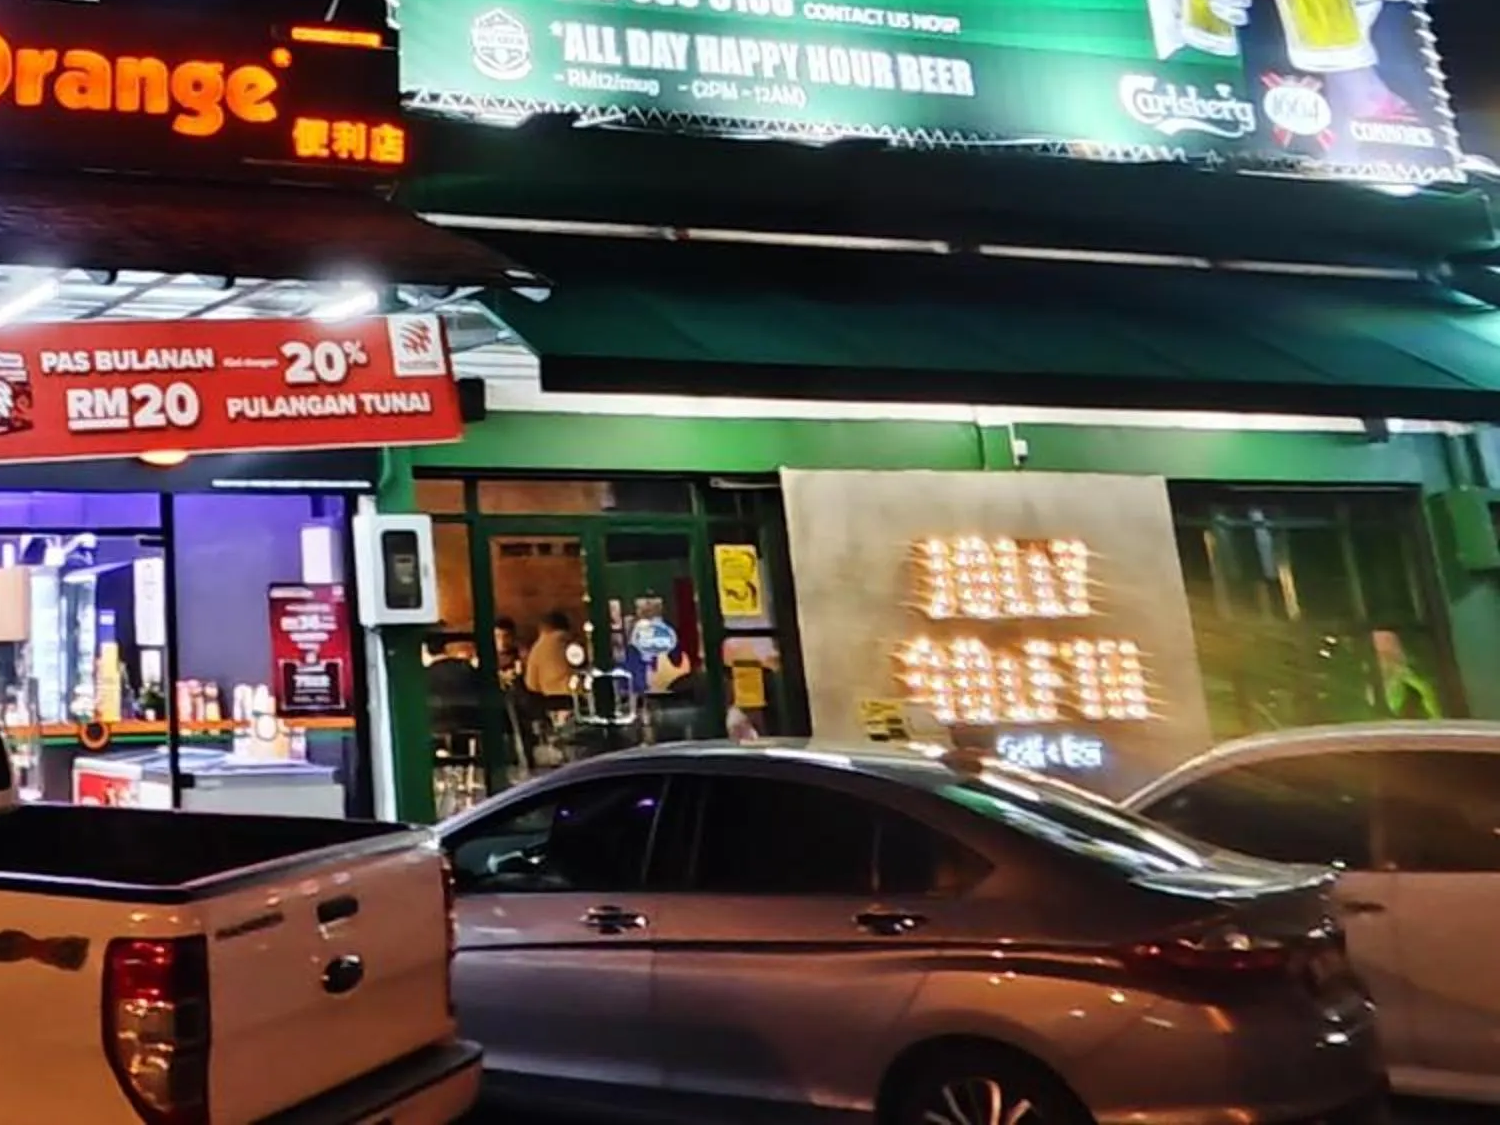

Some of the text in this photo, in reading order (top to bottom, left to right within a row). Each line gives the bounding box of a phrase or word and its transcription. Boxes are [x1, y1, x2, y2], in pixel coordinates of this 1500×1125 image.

[803, 3, 885, 26] CONTACT
[886, 10, 910, 28] US
[625, 28, 690, 71] DAY
[694, 33, 799, 81] HAPPY
[805, 43, 895, 90] HOUR
[896, 52, 976, 97] BEER
[1118, 74, 1256, 133] Carlsberg
[41, 350, 90, 373] PAS
[94, 348, 215, 371] BULANAN
[280, 340, 368, 383] 20%
[66, 381, 200, 431] RM20
[226, 391, 432, 419] PULANGAN TUNAI
